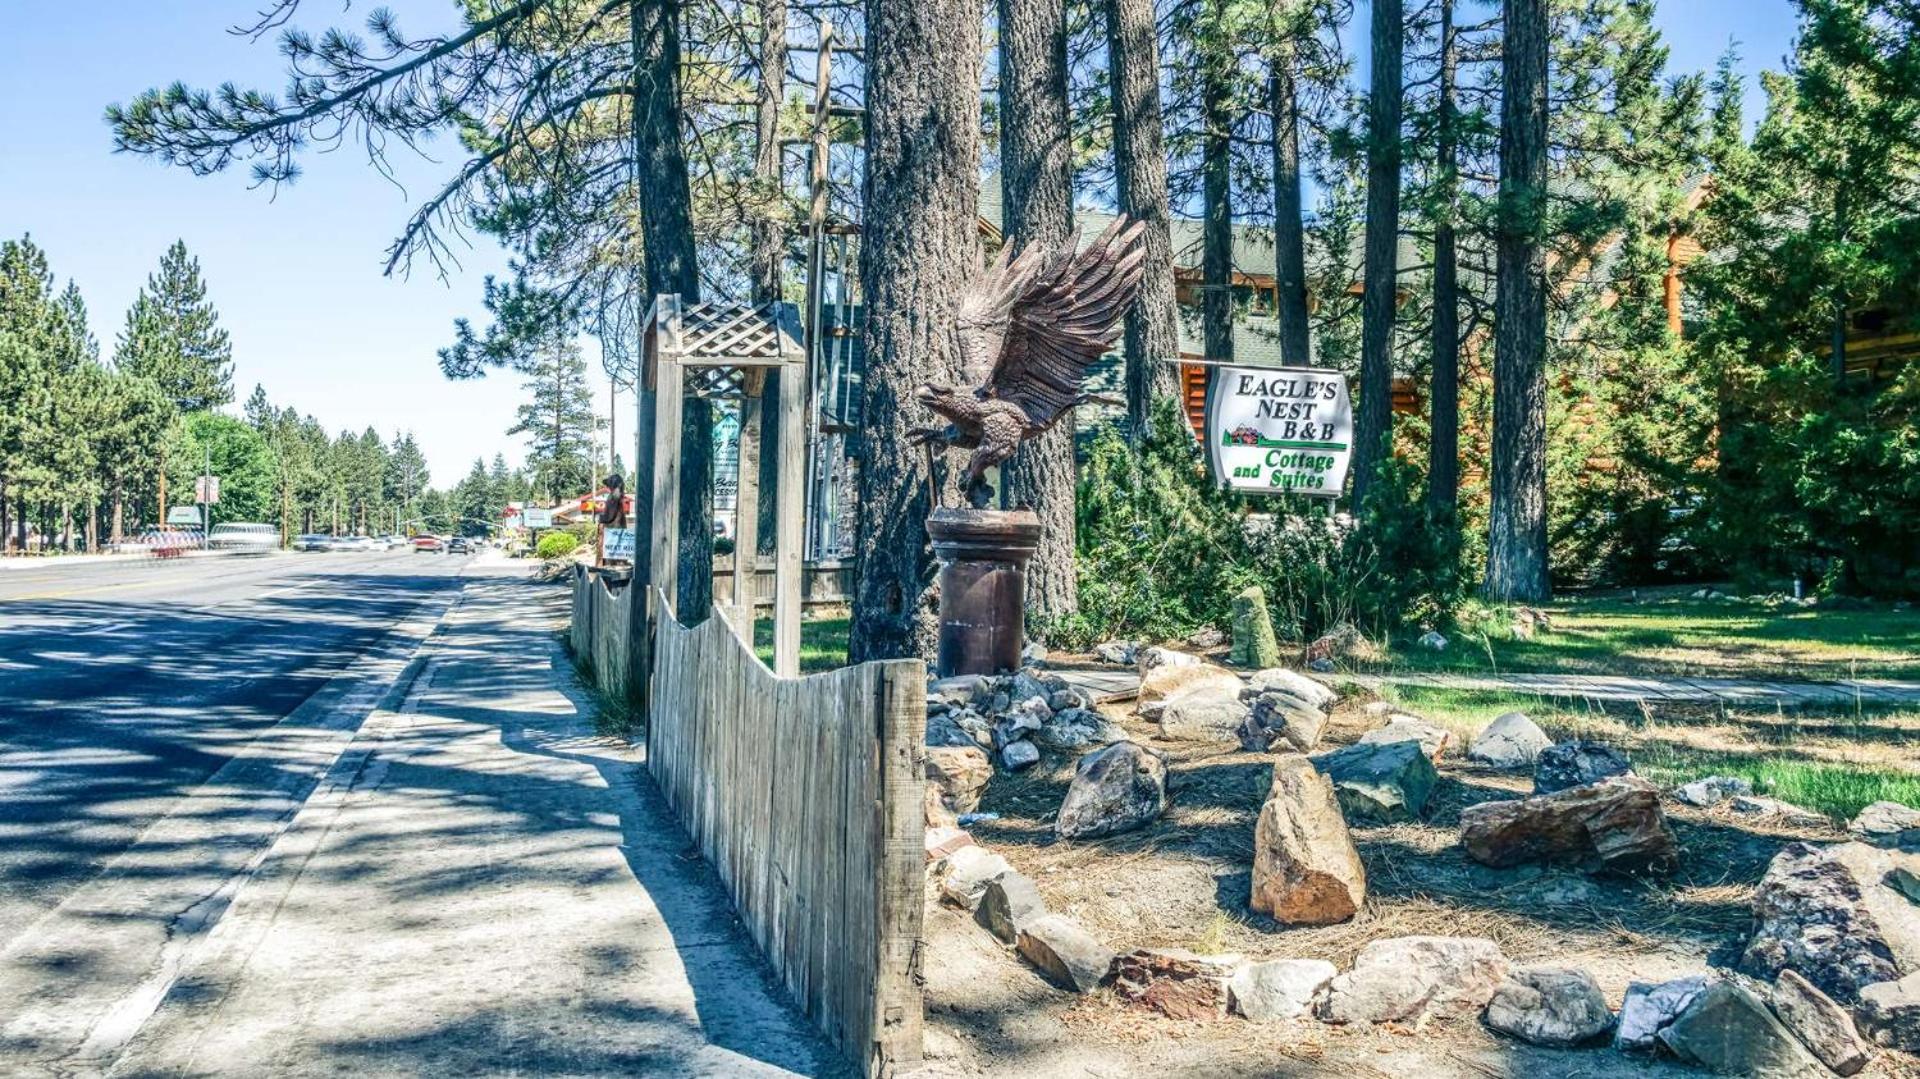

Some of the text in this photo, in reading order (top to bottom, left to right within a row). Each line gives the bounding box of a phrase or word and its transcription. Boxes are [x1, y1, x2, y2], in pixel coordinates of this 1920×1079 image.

[1236, 375, 1337, 400] EAGLE'S
[1255, 399, 1317, 420] NEST
[1265, 449, 1335, 472] Cottage
[1233, 464, 1261, 479] and
[1269, 469, 1325, 489] Suites
